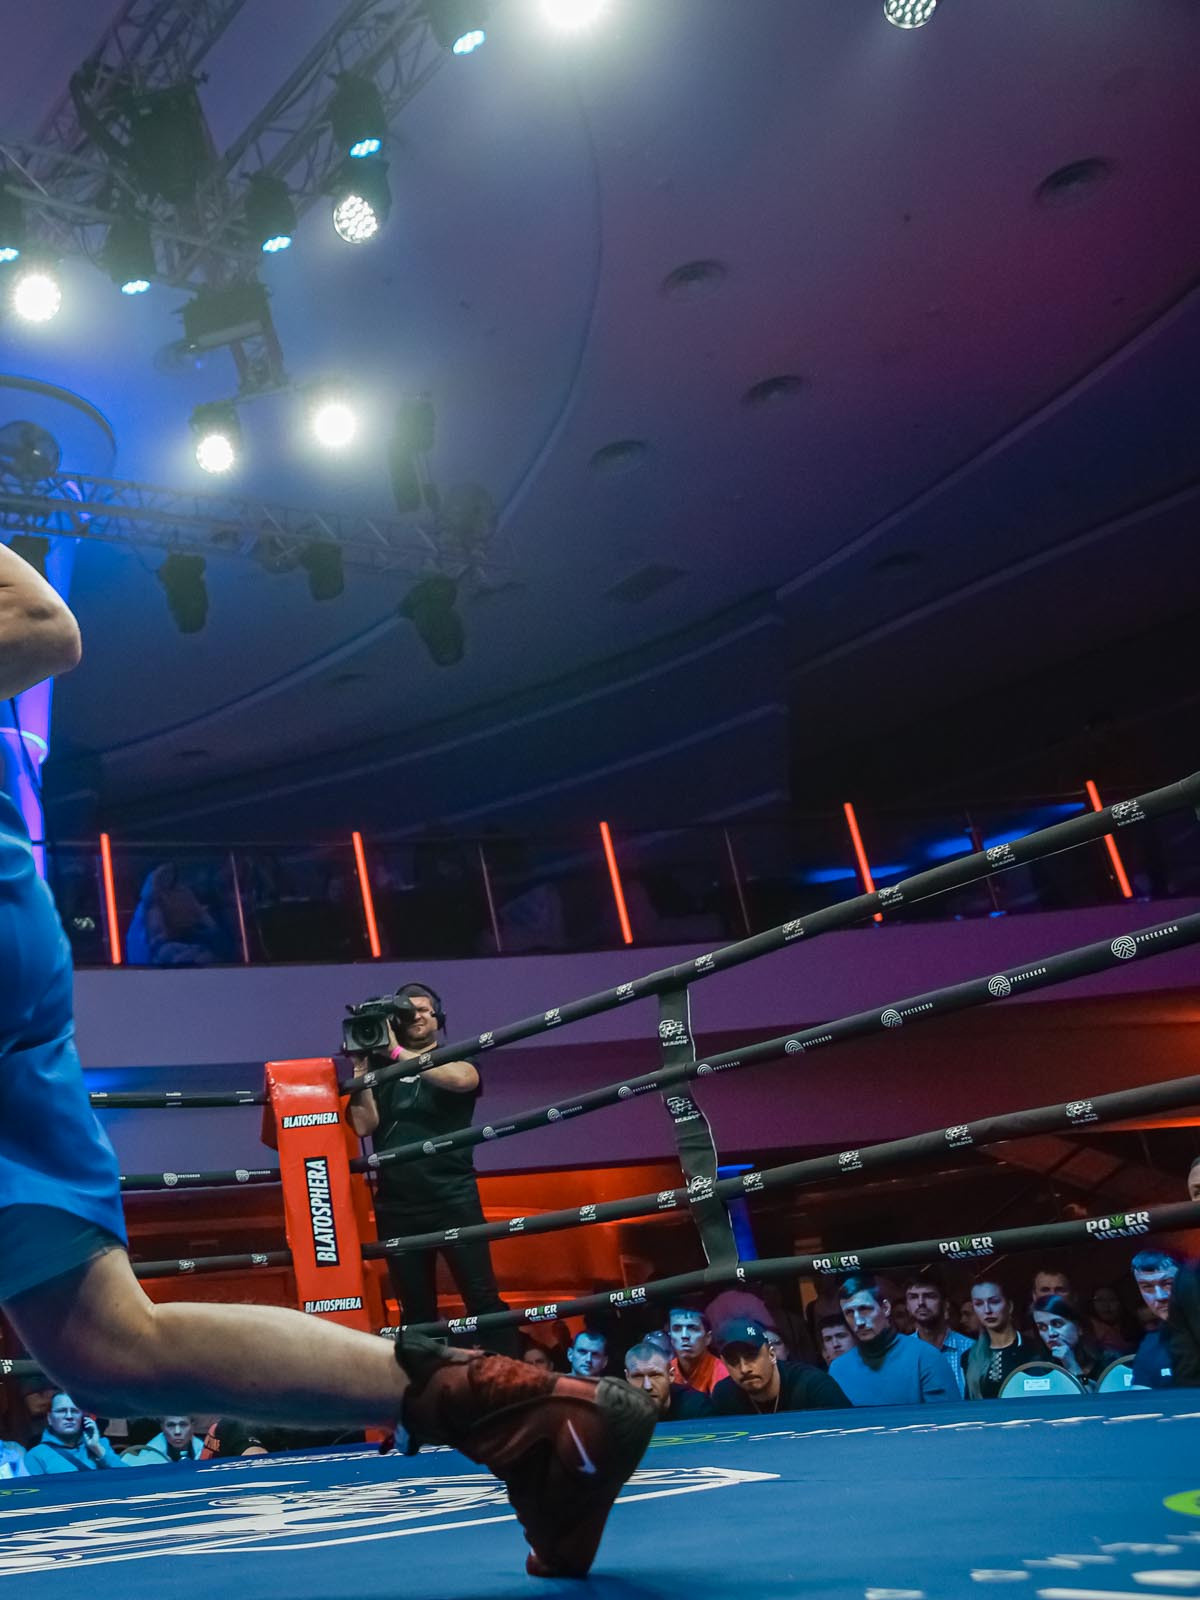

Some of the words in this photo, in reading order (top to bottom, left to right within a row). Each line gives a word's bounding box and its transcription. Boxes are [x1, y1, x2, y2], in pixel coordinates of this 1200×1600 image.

[283, 1112, 339, 1128] BLATOSPHERA
[306, 1159, 337, 1262] BLATOSPHERA
[305, 1297, 362, 1313] BLATOSPHERA
